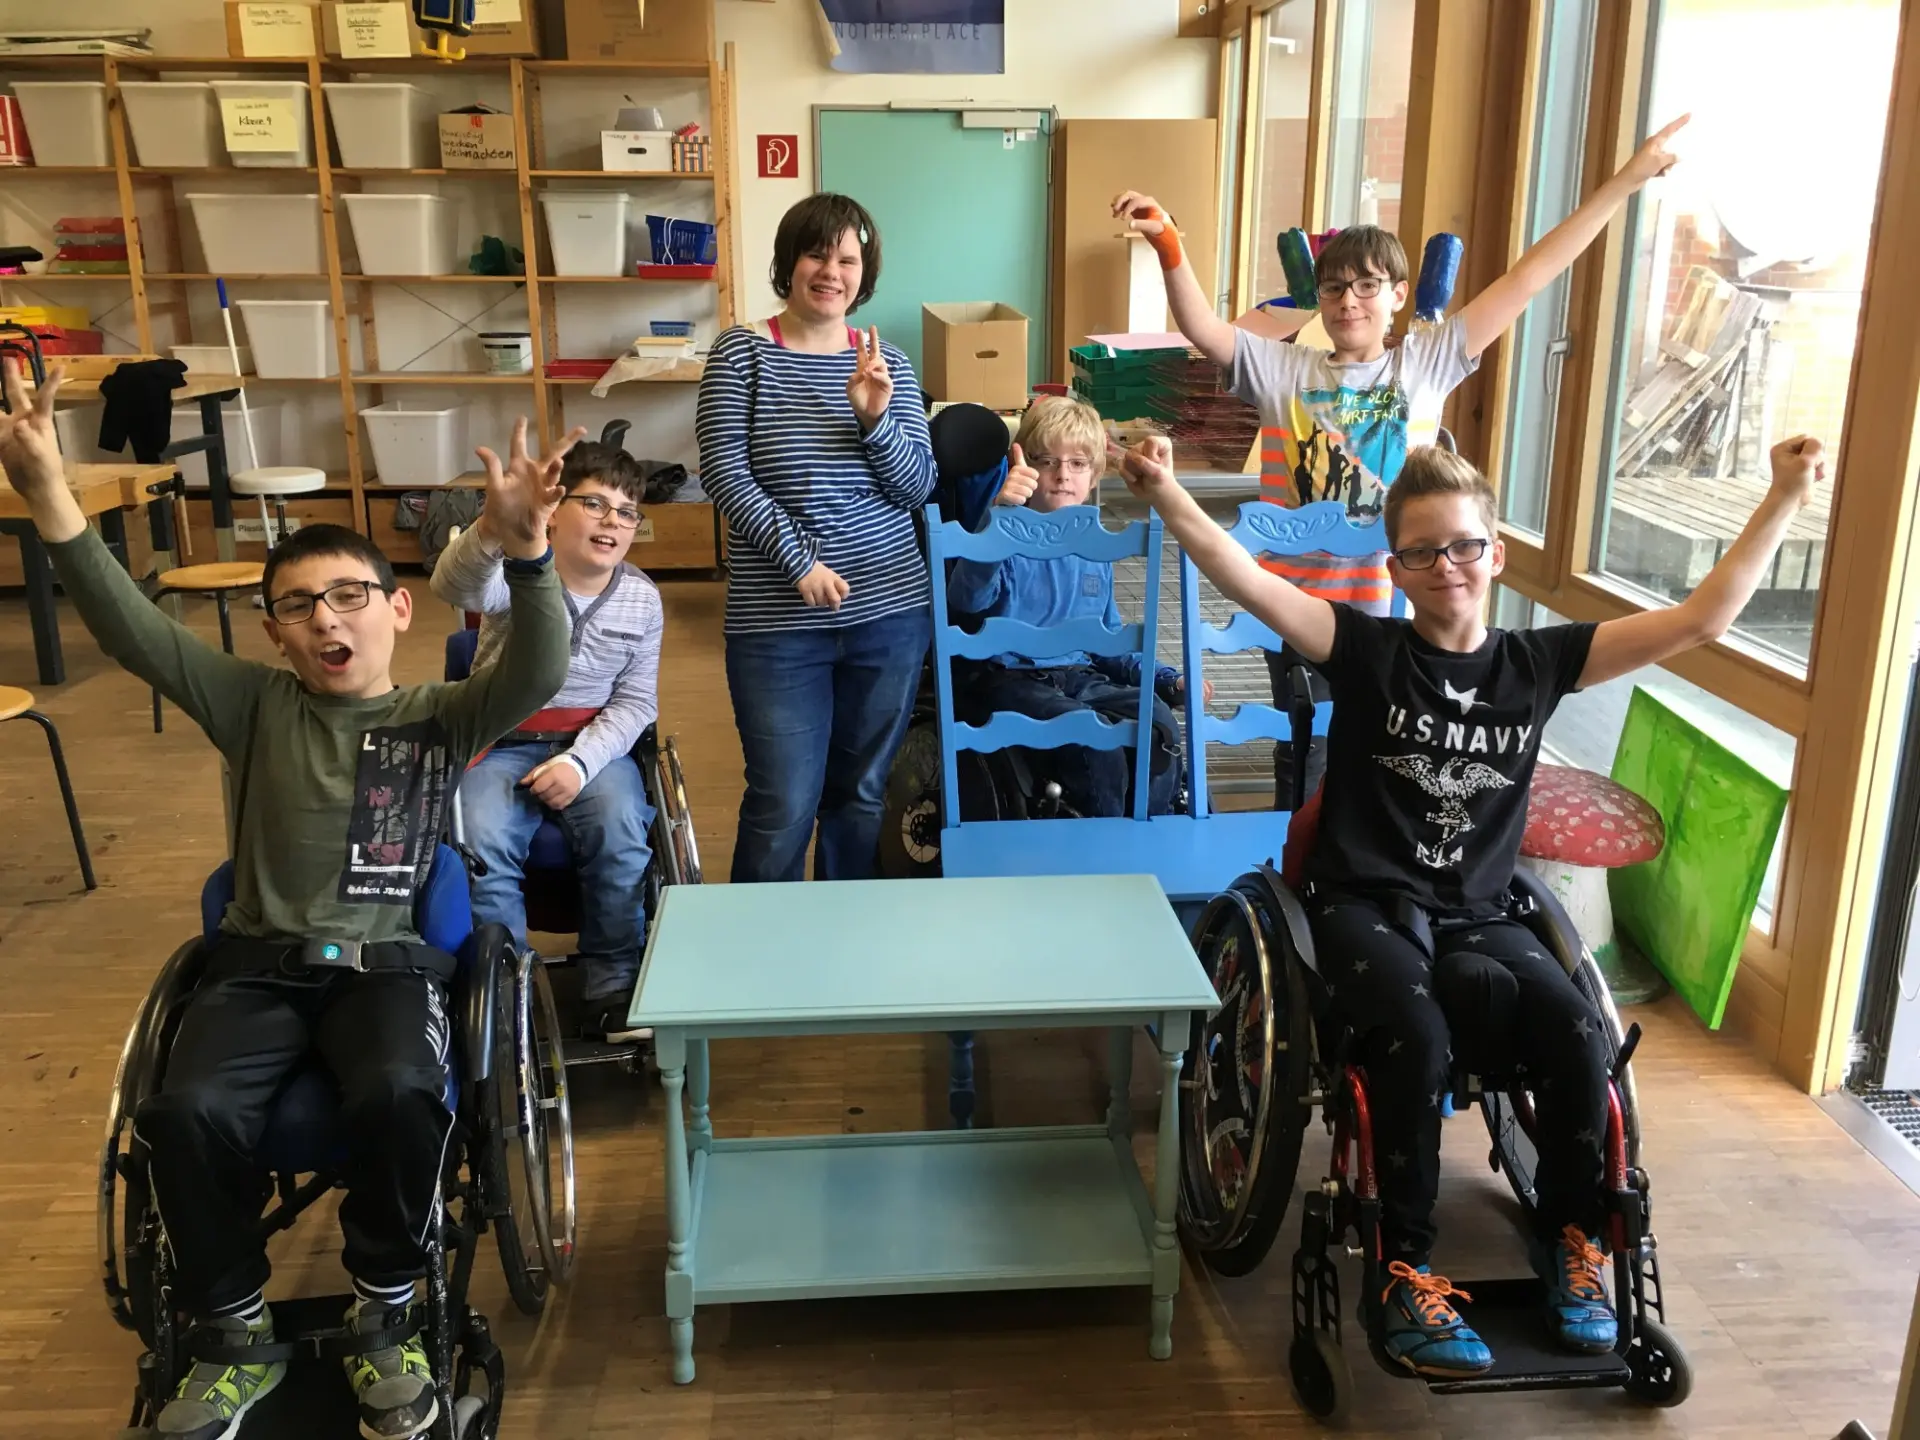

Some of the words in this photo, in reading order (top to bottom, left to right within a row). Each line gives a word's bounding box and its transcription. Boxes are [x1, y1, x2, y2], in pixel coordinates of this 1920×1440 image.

[835, 23, 908, 40] NOTHER
[922, 23, 980, 40] PLACE
[1335, 393, 1363, 407] LIVE
[1373, 405, 1401, 421] FAST
[1444, 722, 1533, 754] NAVY
